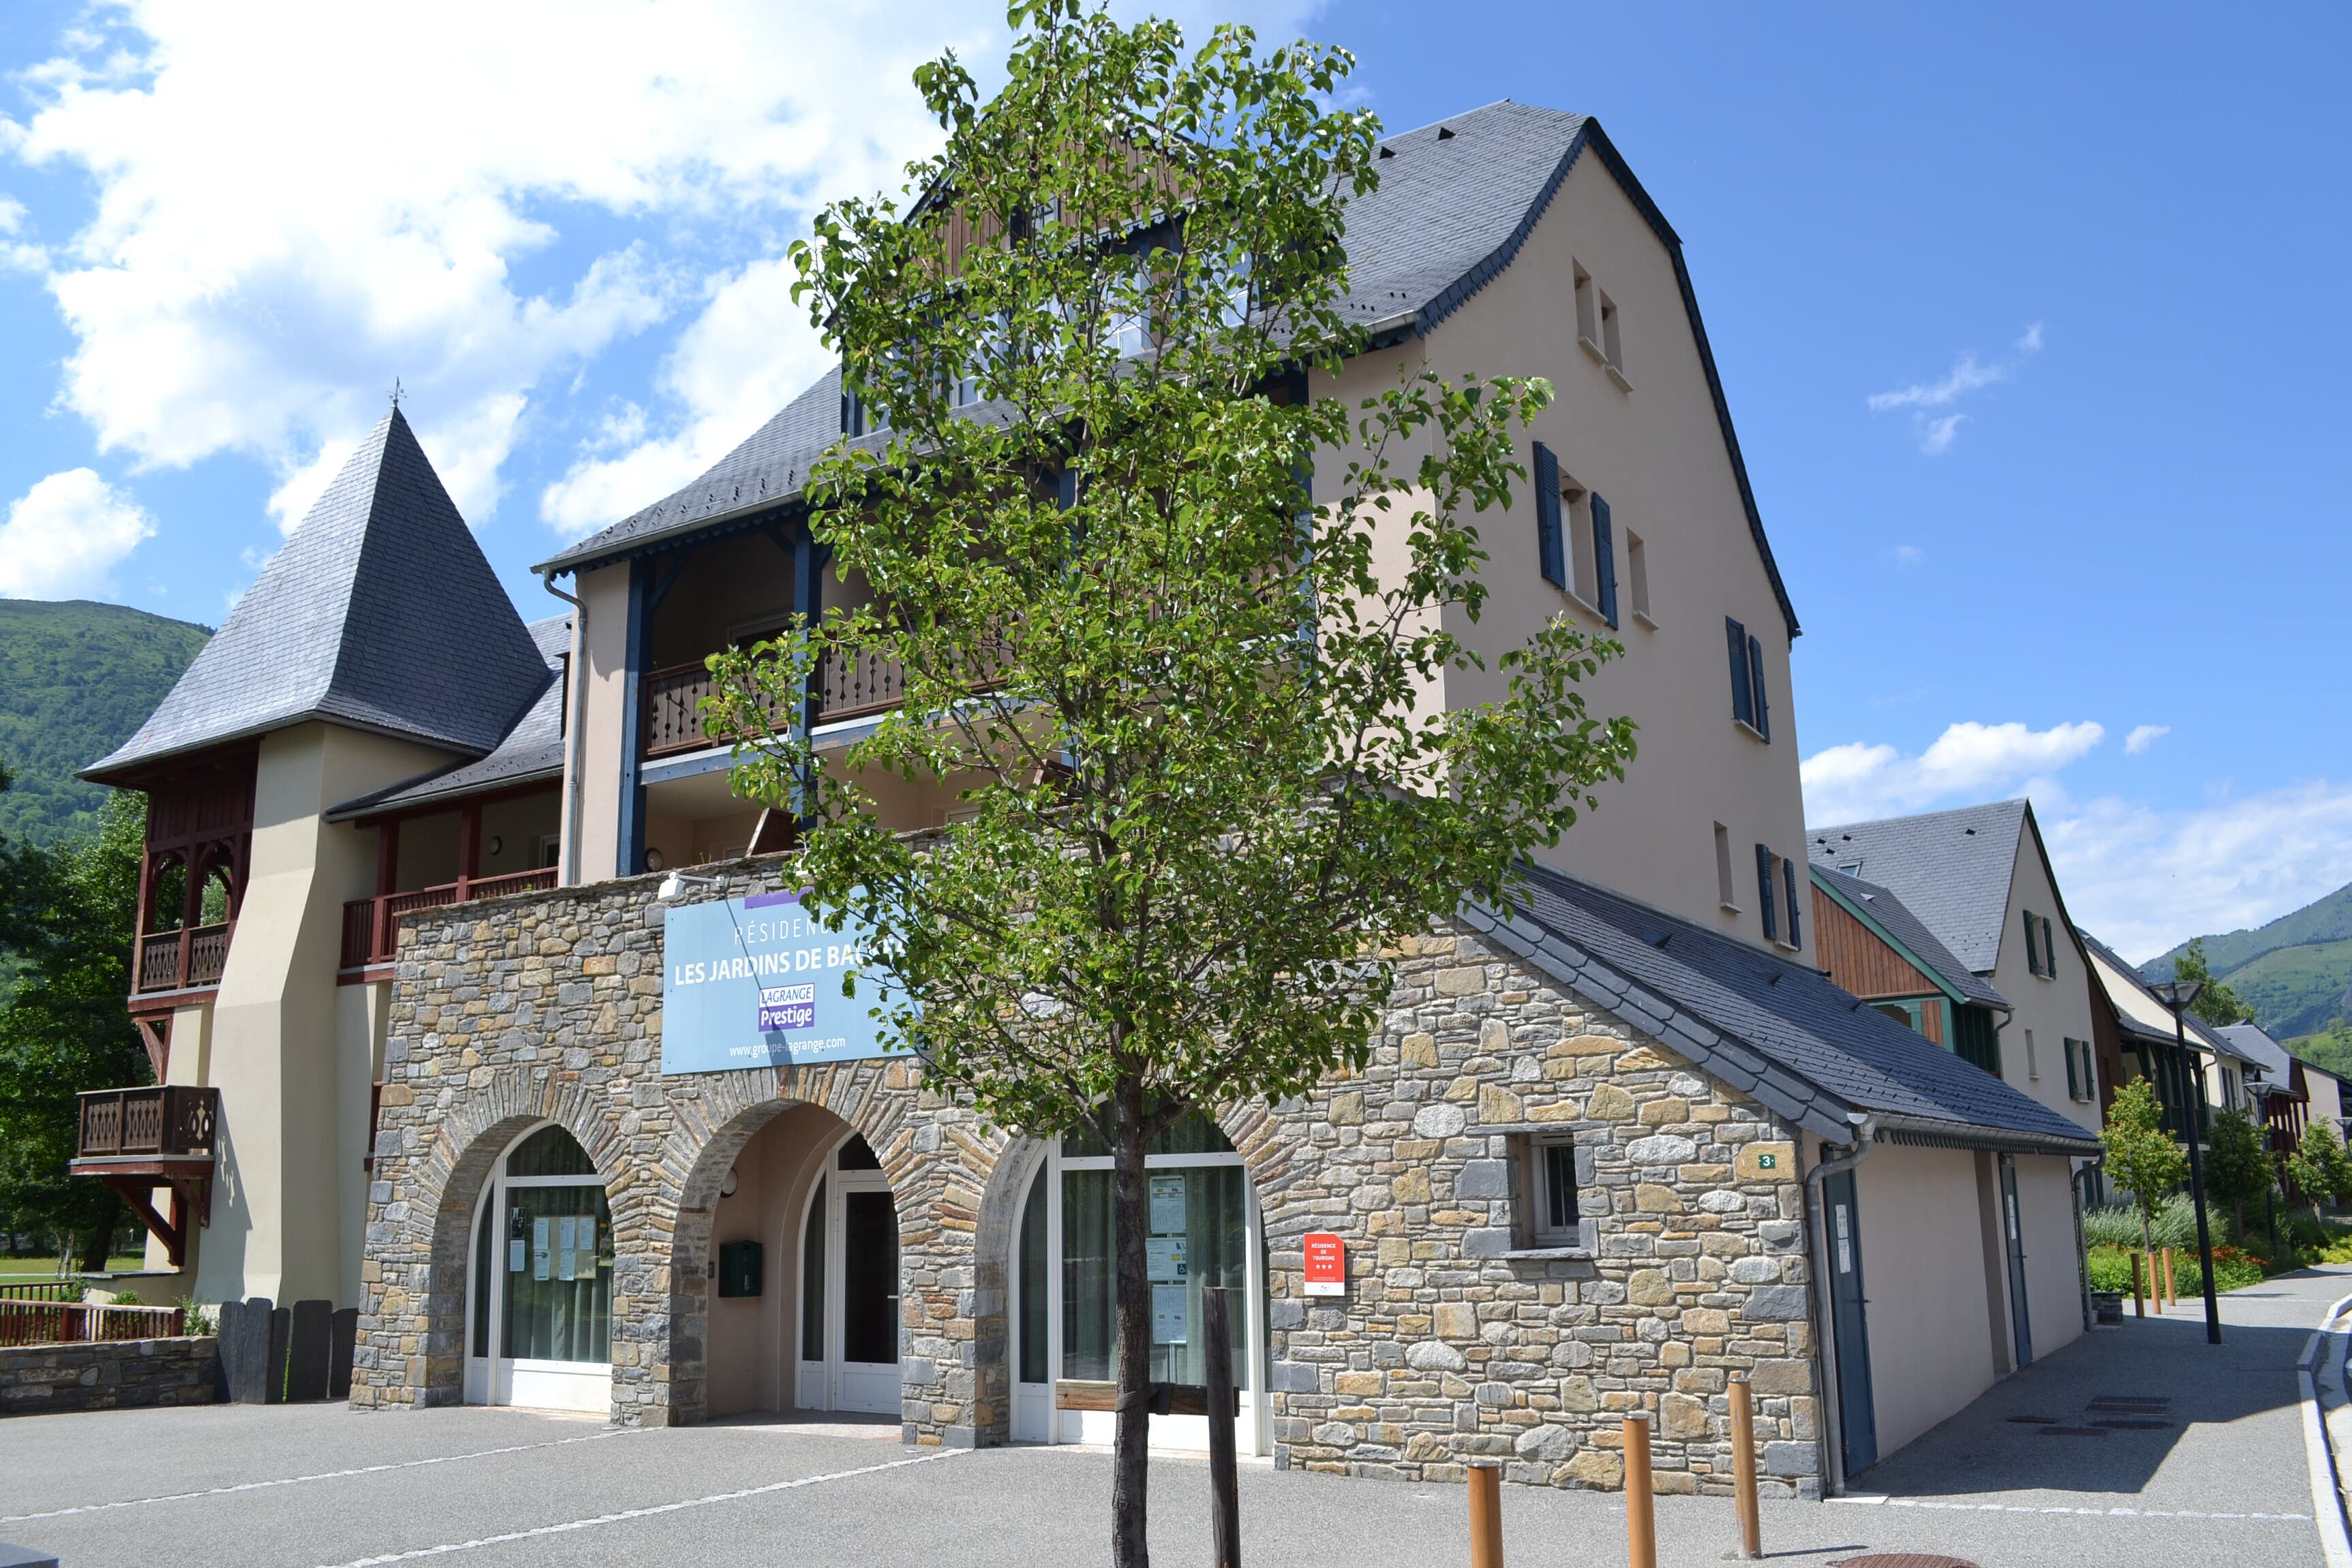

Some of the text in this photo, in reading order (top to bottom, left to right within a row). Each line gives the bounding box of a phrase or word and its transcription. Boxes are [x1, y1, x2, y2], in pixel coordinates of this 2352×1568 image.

[734, 914, 832, 946] RÉSIDENC
[675, 962, 706, 986] LES
[708, 951, 791, 981] JARDINS
[795, 948, 822, 971] DE
[761, 986, 812, 1004] LAGRANGE
[760, 1006, 813, 1027] Prestige
[729, 1037, 846, 1058] www.groupe-lagrange.com
[1762, 1156, 1771, 1166] 3
